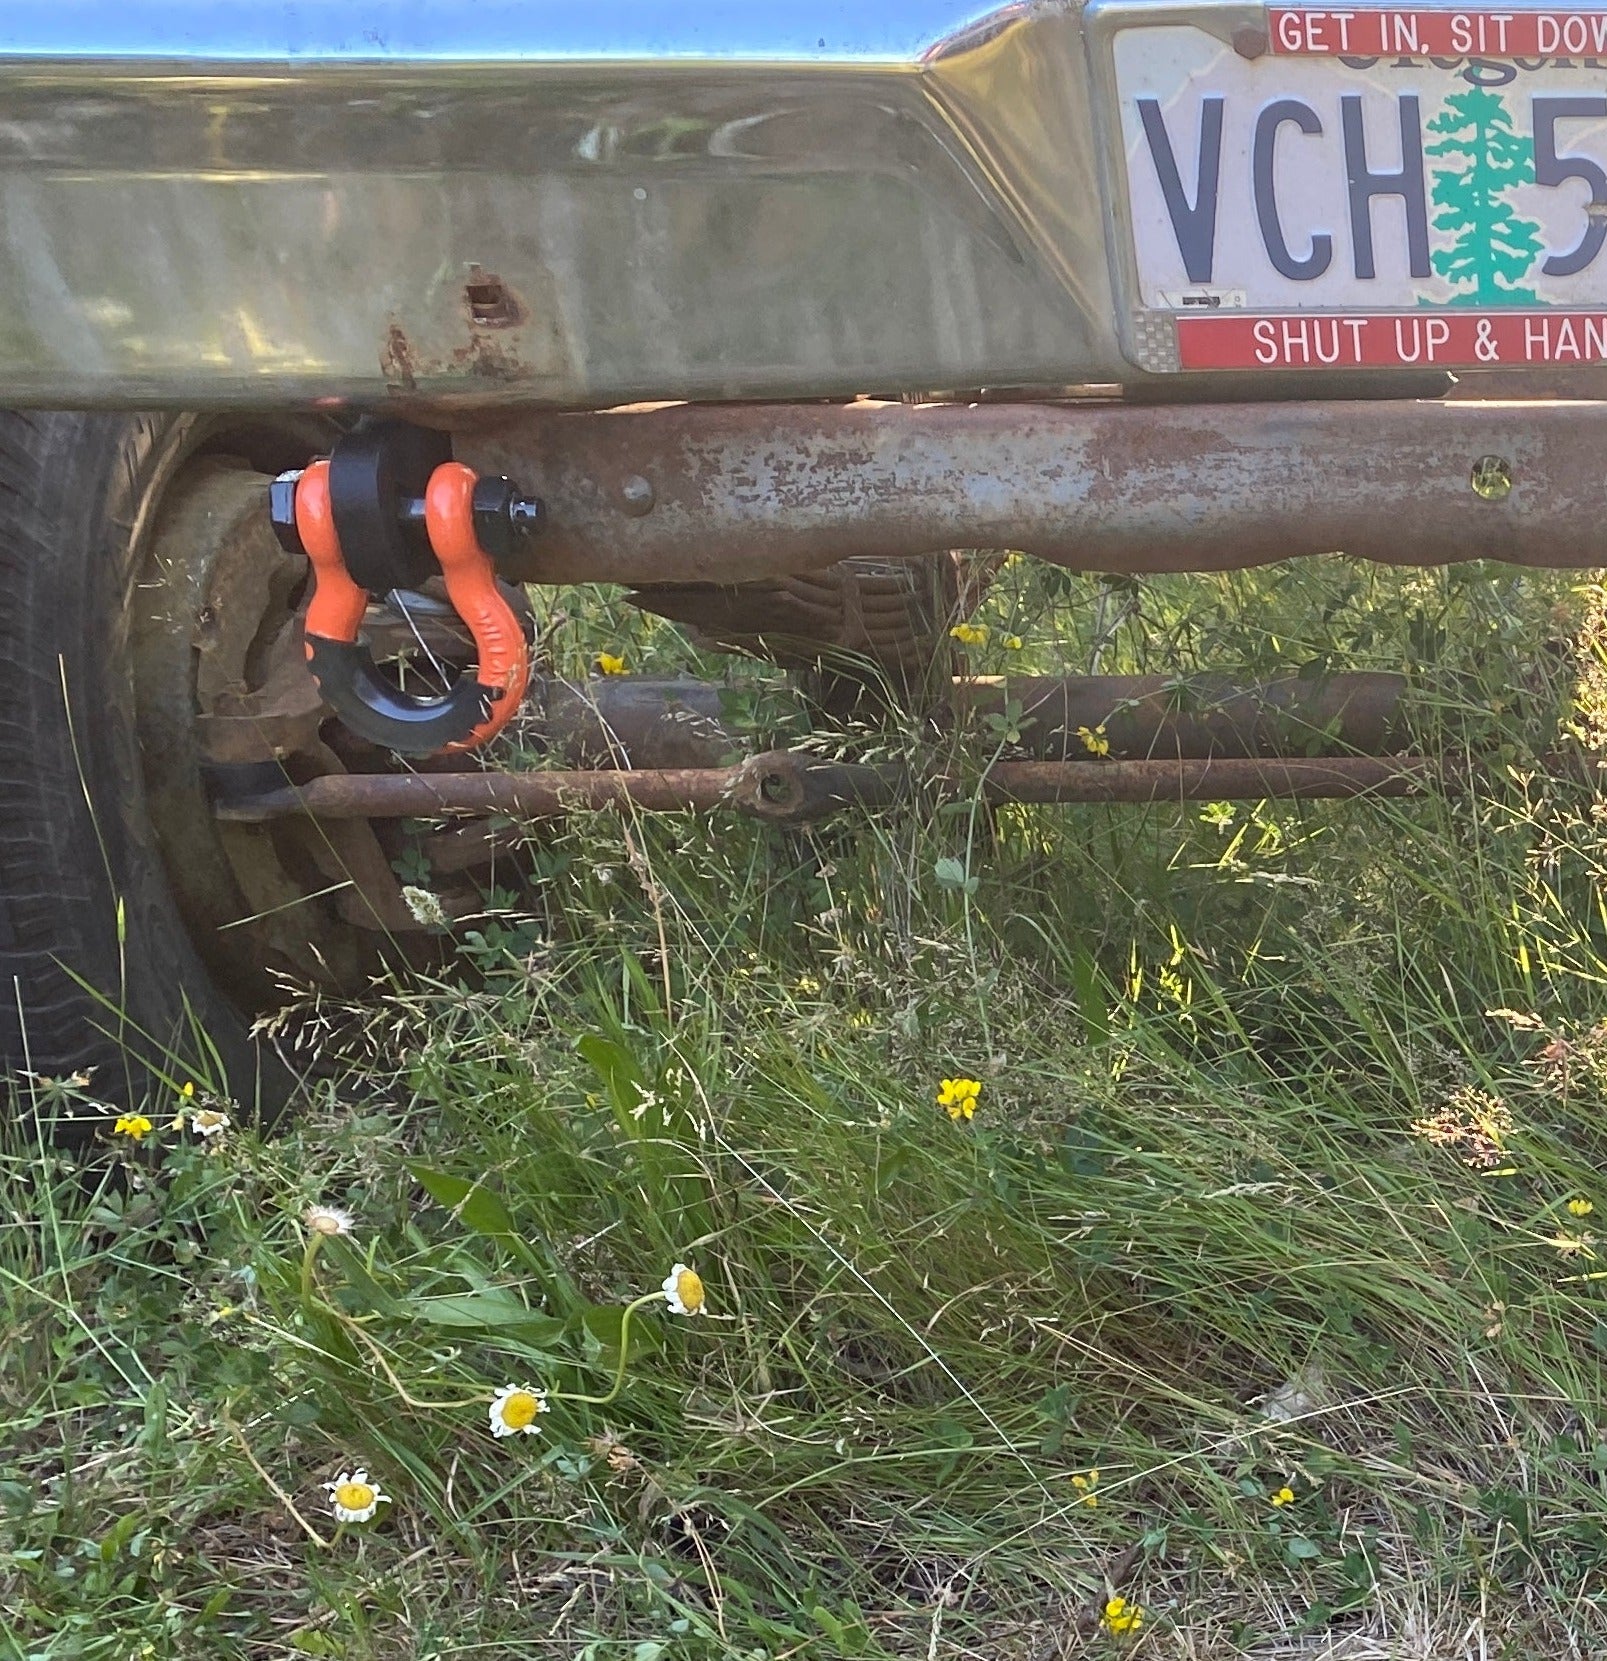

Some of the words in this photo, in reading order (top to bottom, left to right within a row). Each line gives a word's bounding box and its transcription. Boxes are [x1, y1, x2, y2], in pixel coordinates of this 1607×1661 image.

[1278, 12, 1356, 52] GET
[1380, 13, 1429, 55] IN,
[1450, 14, 1514, 53] SIT
[1136, 95, 1431, 283] VCH
[1253, 318, 1368, 364] SHUT
[1394, 318, 1450, 362] UP
[1474, 318, 1500, 361] &
